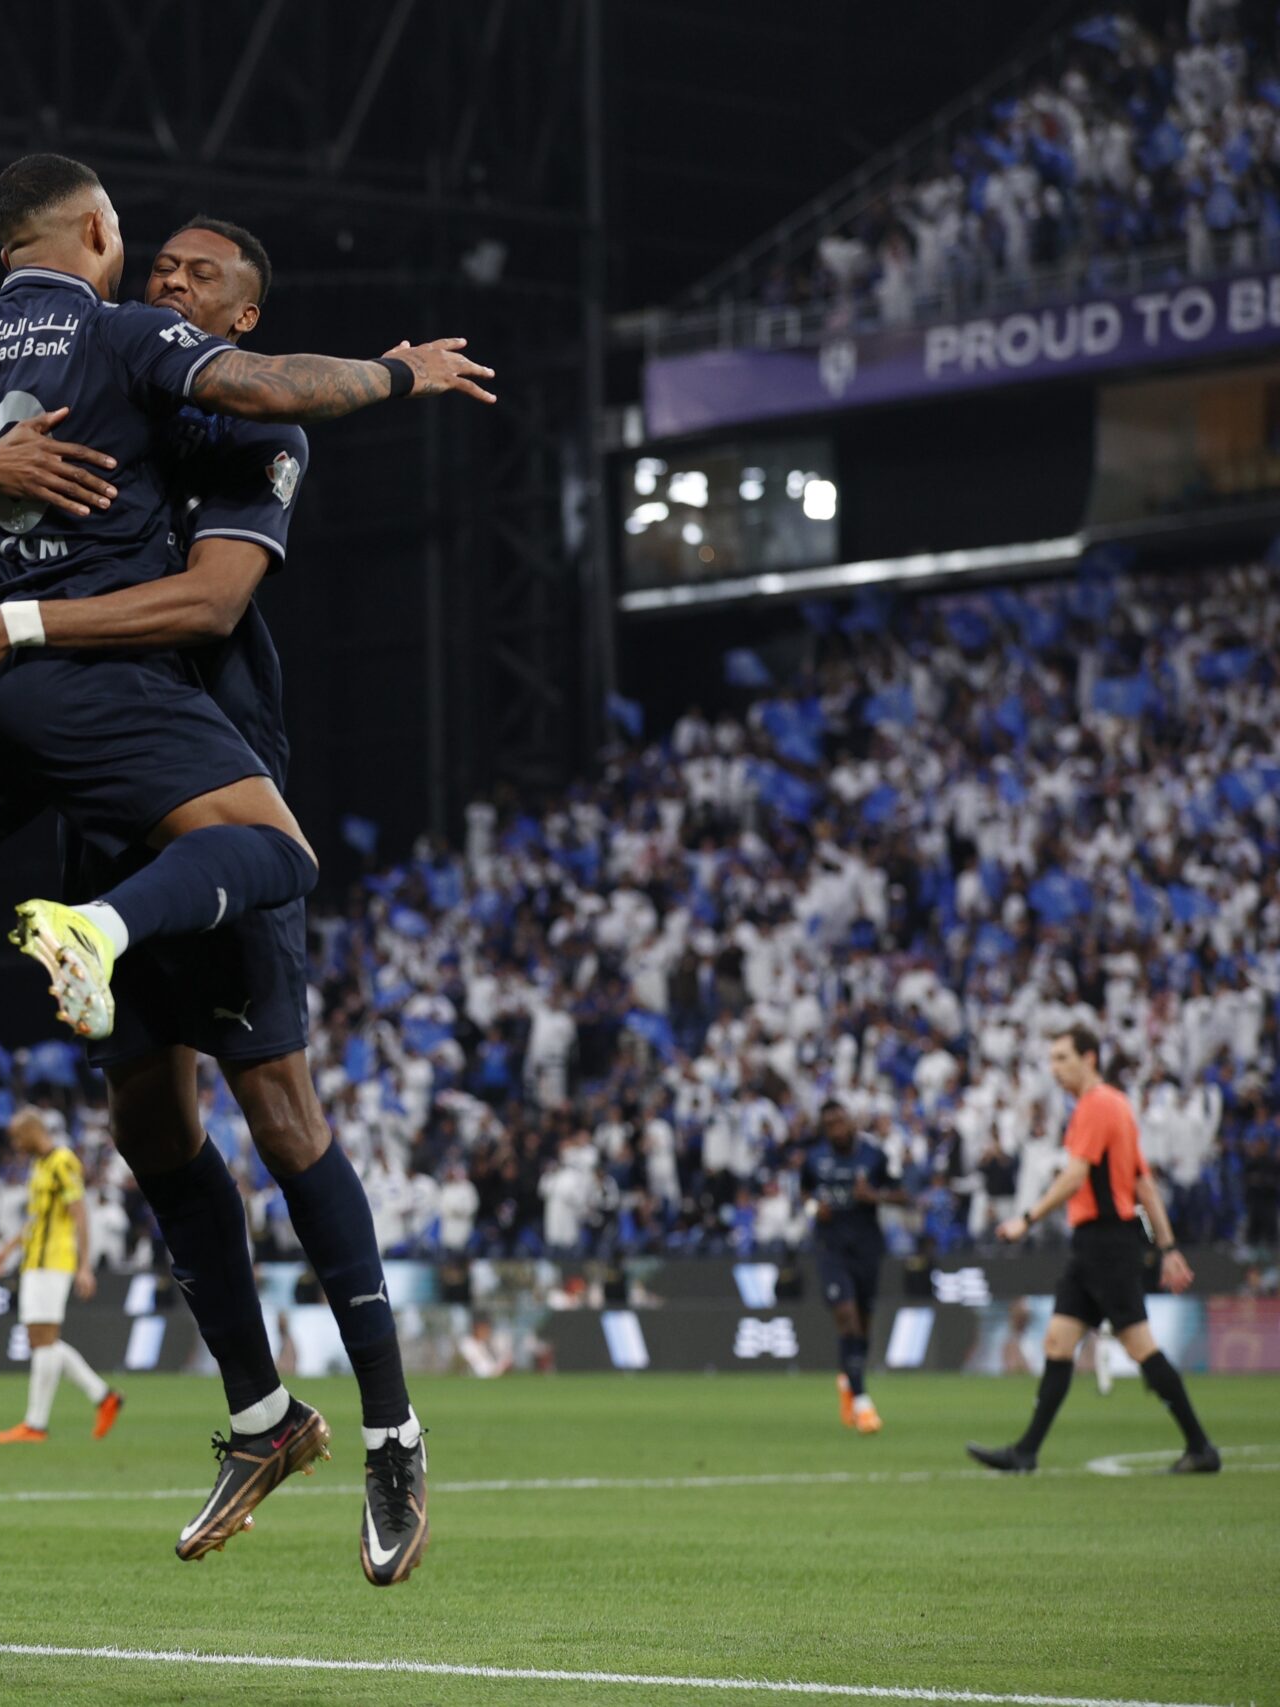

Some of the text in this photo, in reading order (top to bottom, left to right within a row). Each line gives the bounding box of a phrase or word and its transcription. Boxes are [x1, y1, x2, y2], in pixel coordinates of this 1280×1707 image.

[21, 336, 70, 357] Bank
[924, 302, 1123, 378] PROUD
[1133, 288, 1217, 346] TO
